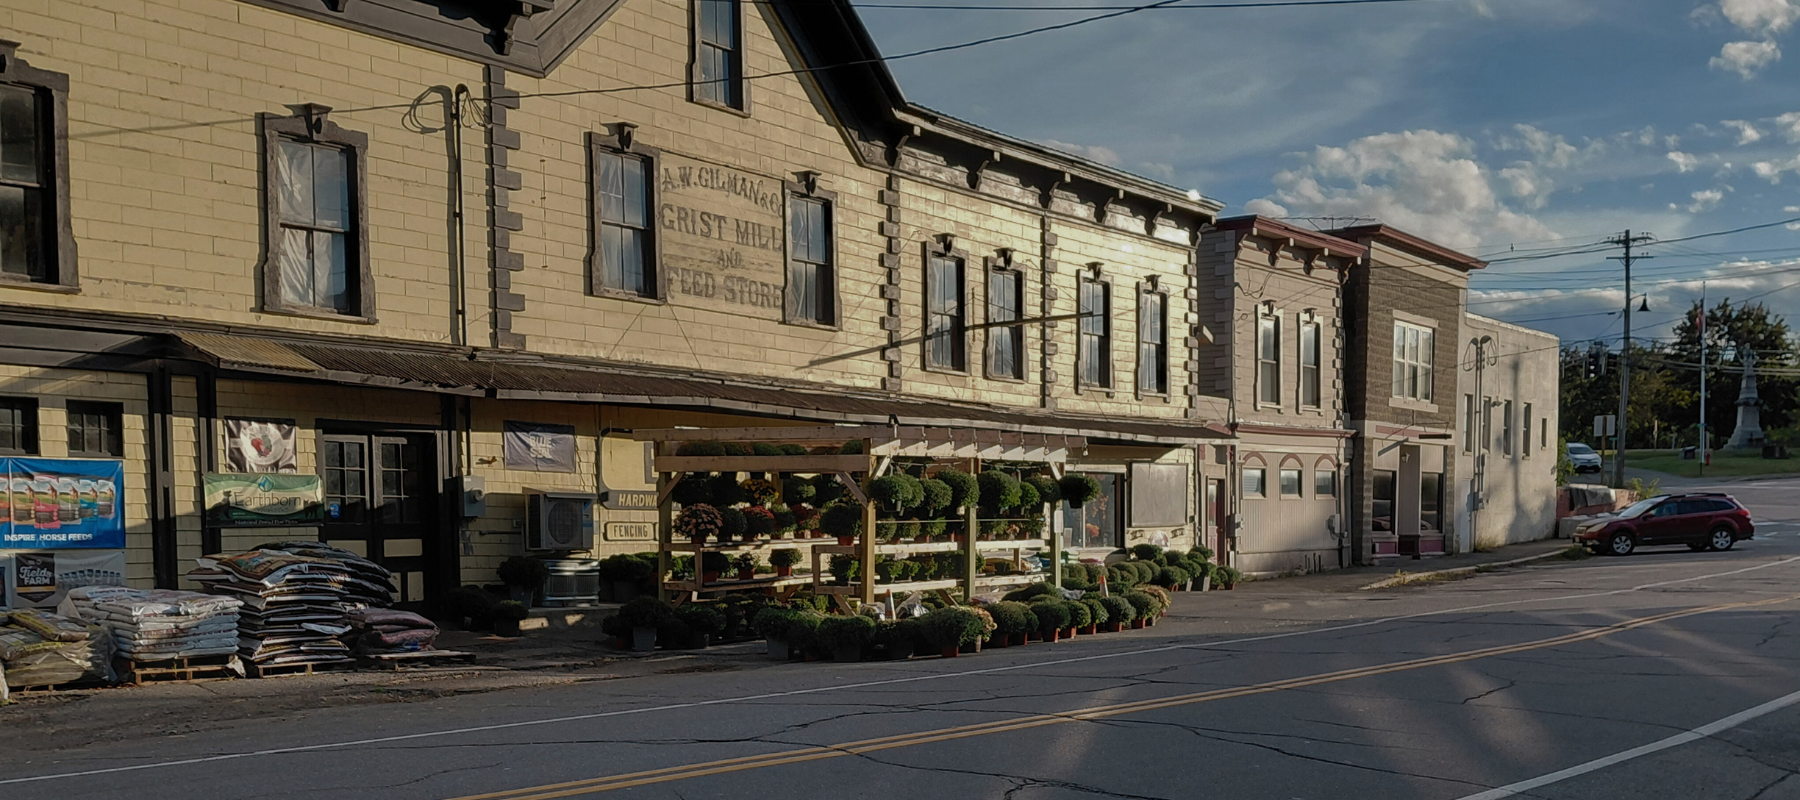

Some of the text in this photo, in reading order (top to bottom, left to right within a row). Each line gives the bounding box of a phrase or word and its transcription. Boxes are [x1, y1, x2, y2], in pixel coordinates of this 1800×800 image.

[698, 167, 764, 205] GILMAN
[661, 203, 782, 251] GRIST MILL
[717, 247, 744, 270] AND
[664, 263, 782, 309] FEED STORE
[530, 435, 553, 448] BLUE
[234, 491, 302, 506] Earthborn
[619, 493, 658, 507] HARDWA
[4, 533, 93, 541] INSPIRE HORSE FEEDS
[613, 524, 648, 538] FENCING
[24, 577, 50, 585] FARM
